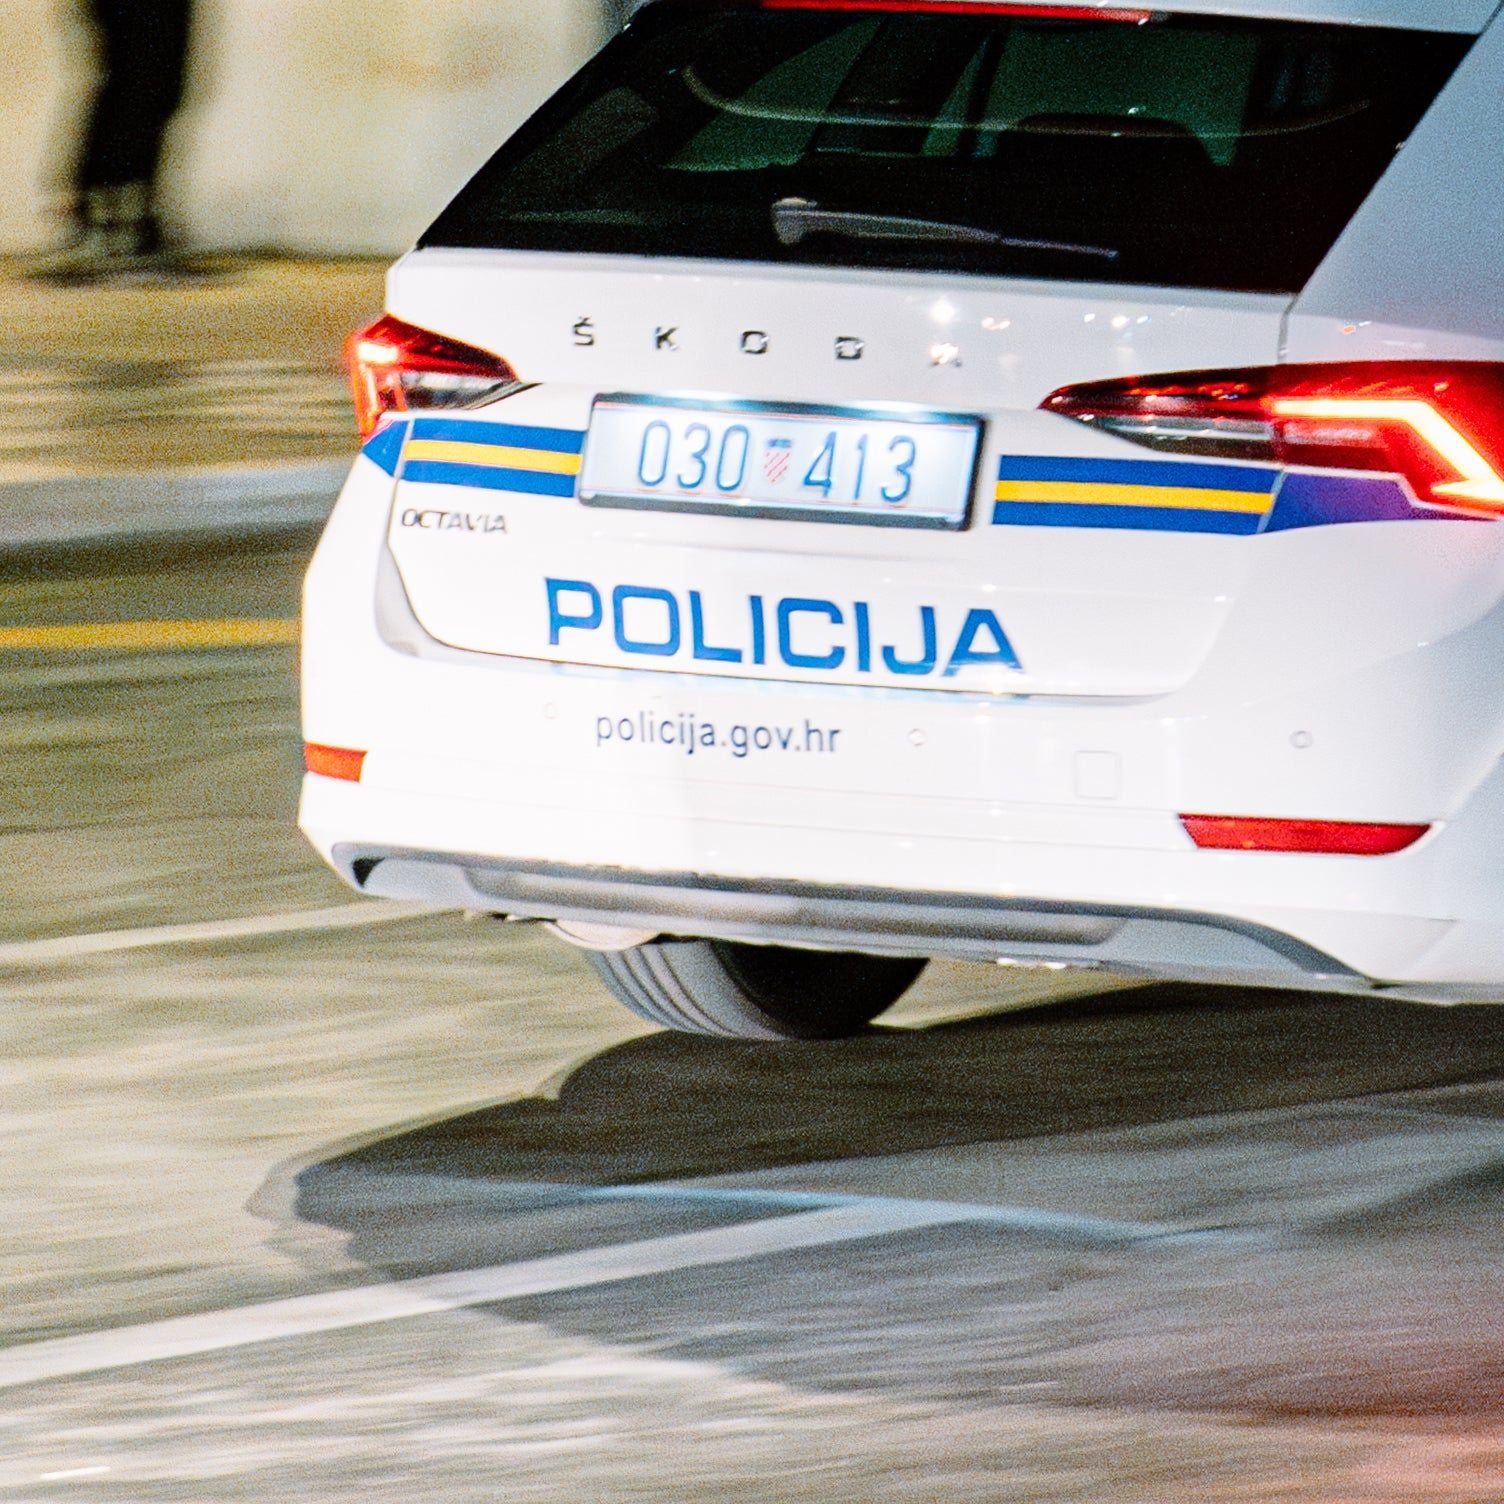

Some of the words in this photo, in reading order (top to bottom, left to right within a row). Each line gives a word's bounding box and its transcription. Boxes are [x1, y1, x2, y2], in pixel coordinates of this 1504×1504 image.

[638, 418, 751, 493] 030
[802, 430, 918, 504] 413
[400, 507, 508, 534] OCTAVIA
[543, 576, 1025, 677] POLICIJA
[596, 709, 842, 758] policija.gov.hr
